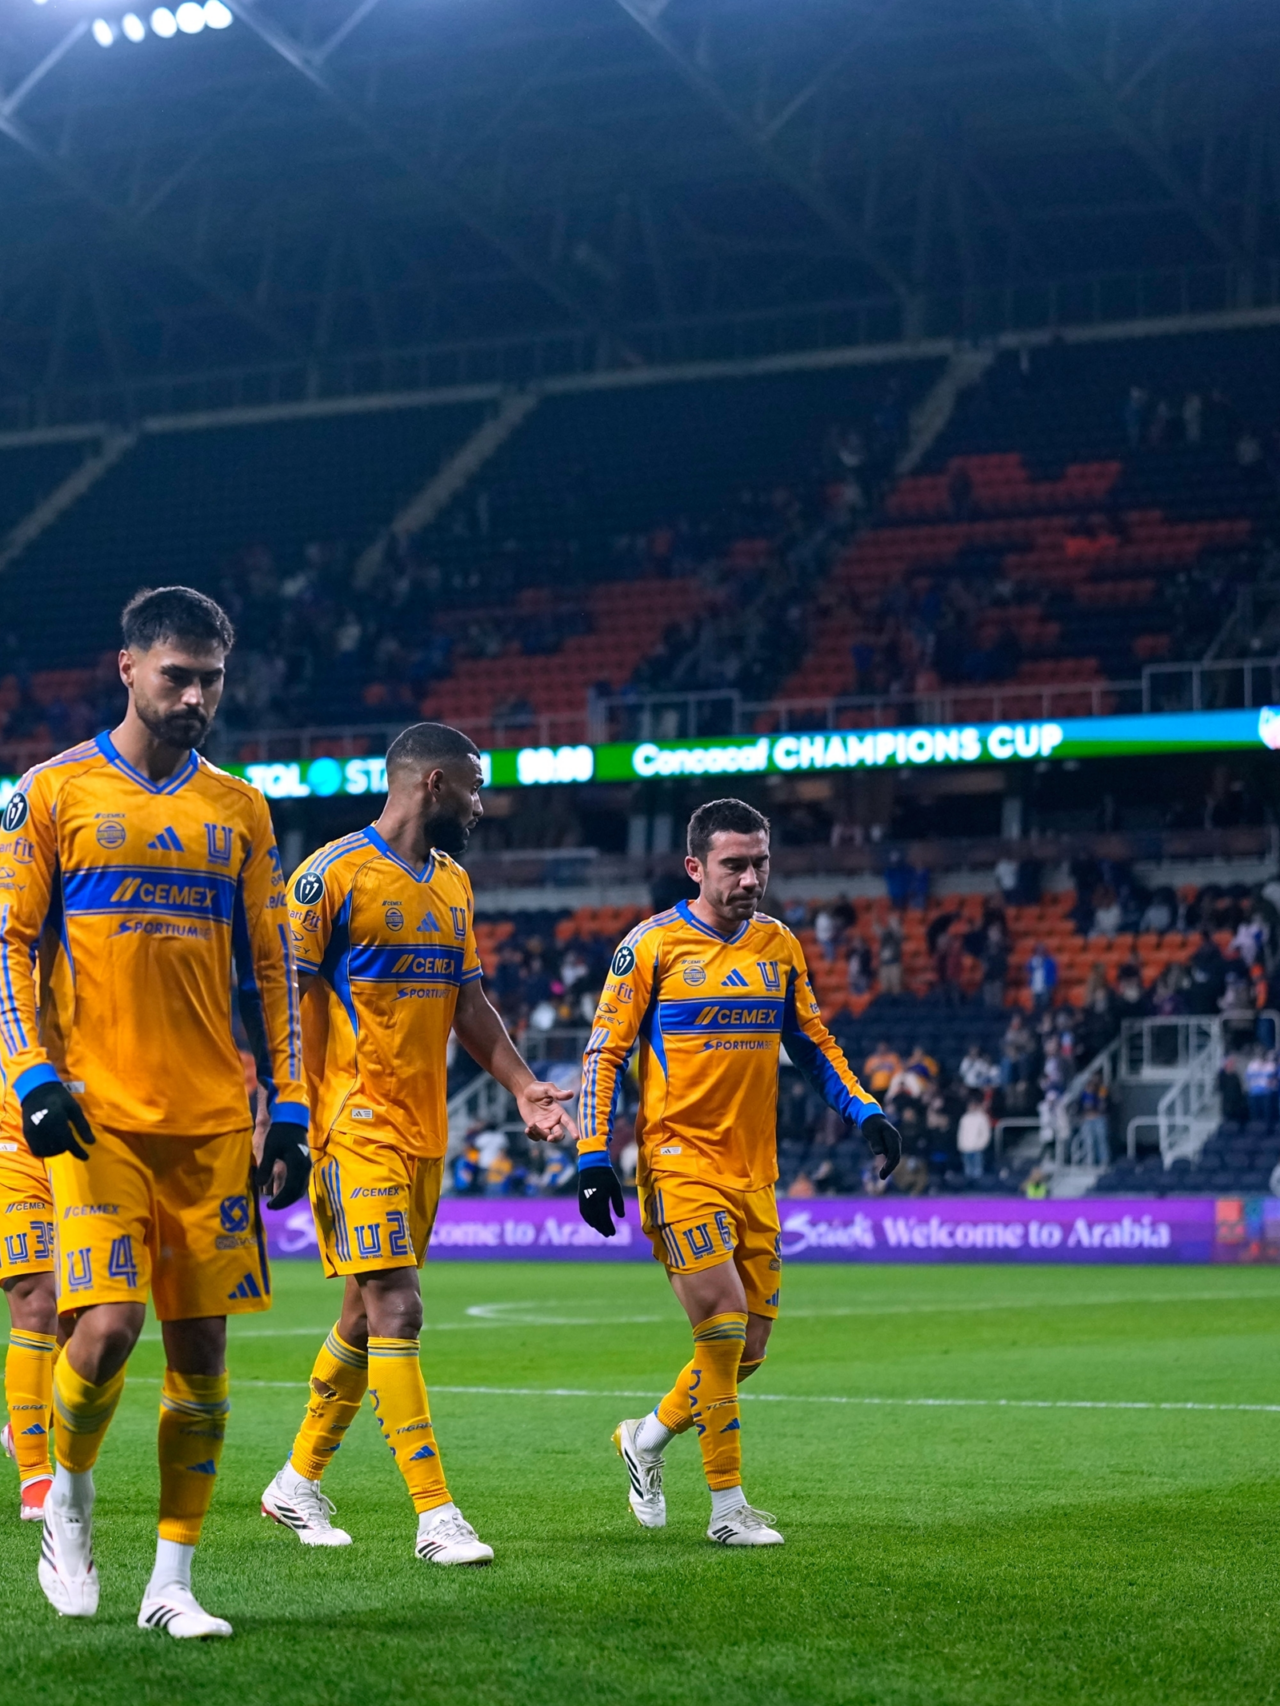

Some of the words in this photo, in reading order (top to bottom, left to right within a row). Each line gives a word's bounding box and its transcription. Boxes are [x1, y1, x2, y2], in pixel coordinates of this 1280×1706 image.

[633, 738, 768, 777] Concacaf
[773, 728, 981, 769] CHAMPIONS
[987, 723, 1063, 759] CUP
[14, 837, 35, 858] fit
[140, 882, 217, 908] CEMEX
[303, 909, 322, 929] fit
[617, 982, 634, 1000] fit
[718, 1009, 777, 1025] CEMEX
[362, 1186, 400, 1198] CEMEX
[16, 1202, 46, 1211] CEMEX
[72, 1204, 120, 1217] CEMEX
[503, 1218, 536, 1247] to
[538, 1216, 633, 1247] Araa
[882, 1215, 1025, 1248] Welcome
[1028, 1218, 1063, 1248] to
[1068, 1215, 1171, 1249] Arabia
[109, 1235, 137, 1289] 4
